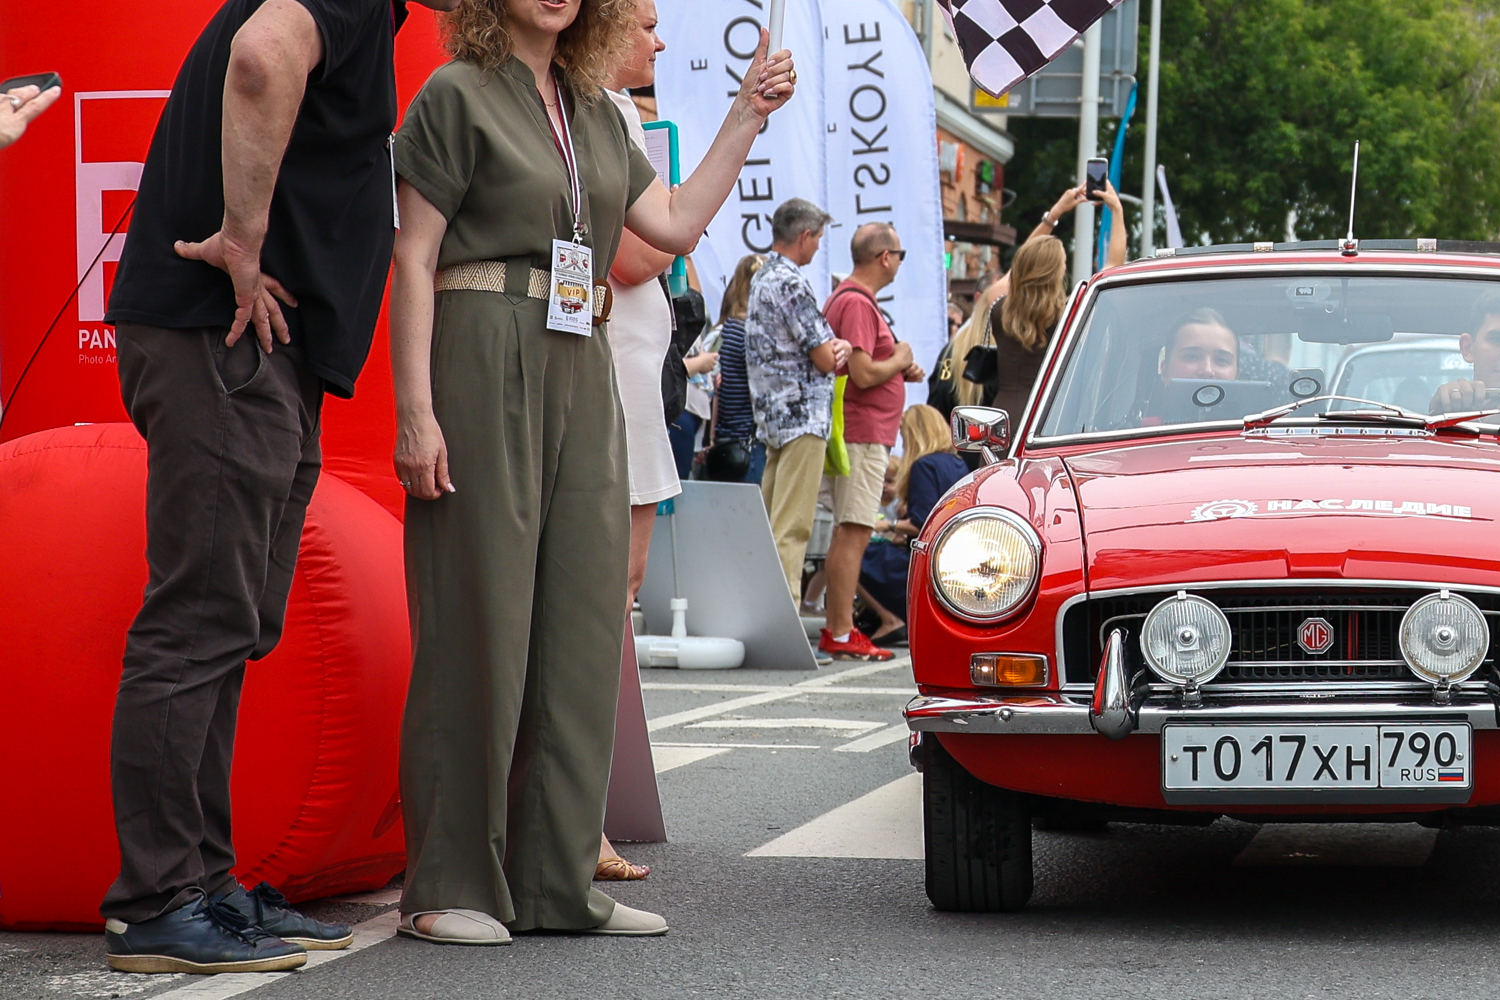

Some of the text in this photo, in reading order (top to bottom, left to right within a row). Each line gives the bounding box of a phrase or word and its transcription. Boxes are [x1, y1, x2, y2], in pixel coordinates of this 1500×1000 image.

[567, 289, 580, 297] VIP
[78, 329, 117, 349] PAN
[79, 354, 103, 364] Photo
[1267, 499, 1472, 517] НАСЛЕДИЕ
[1303, 622, 1329, 650] MG
[1182, 731, 1457, 781] Т017ХН 790
[1401, 768, 1436, 782] RUS
